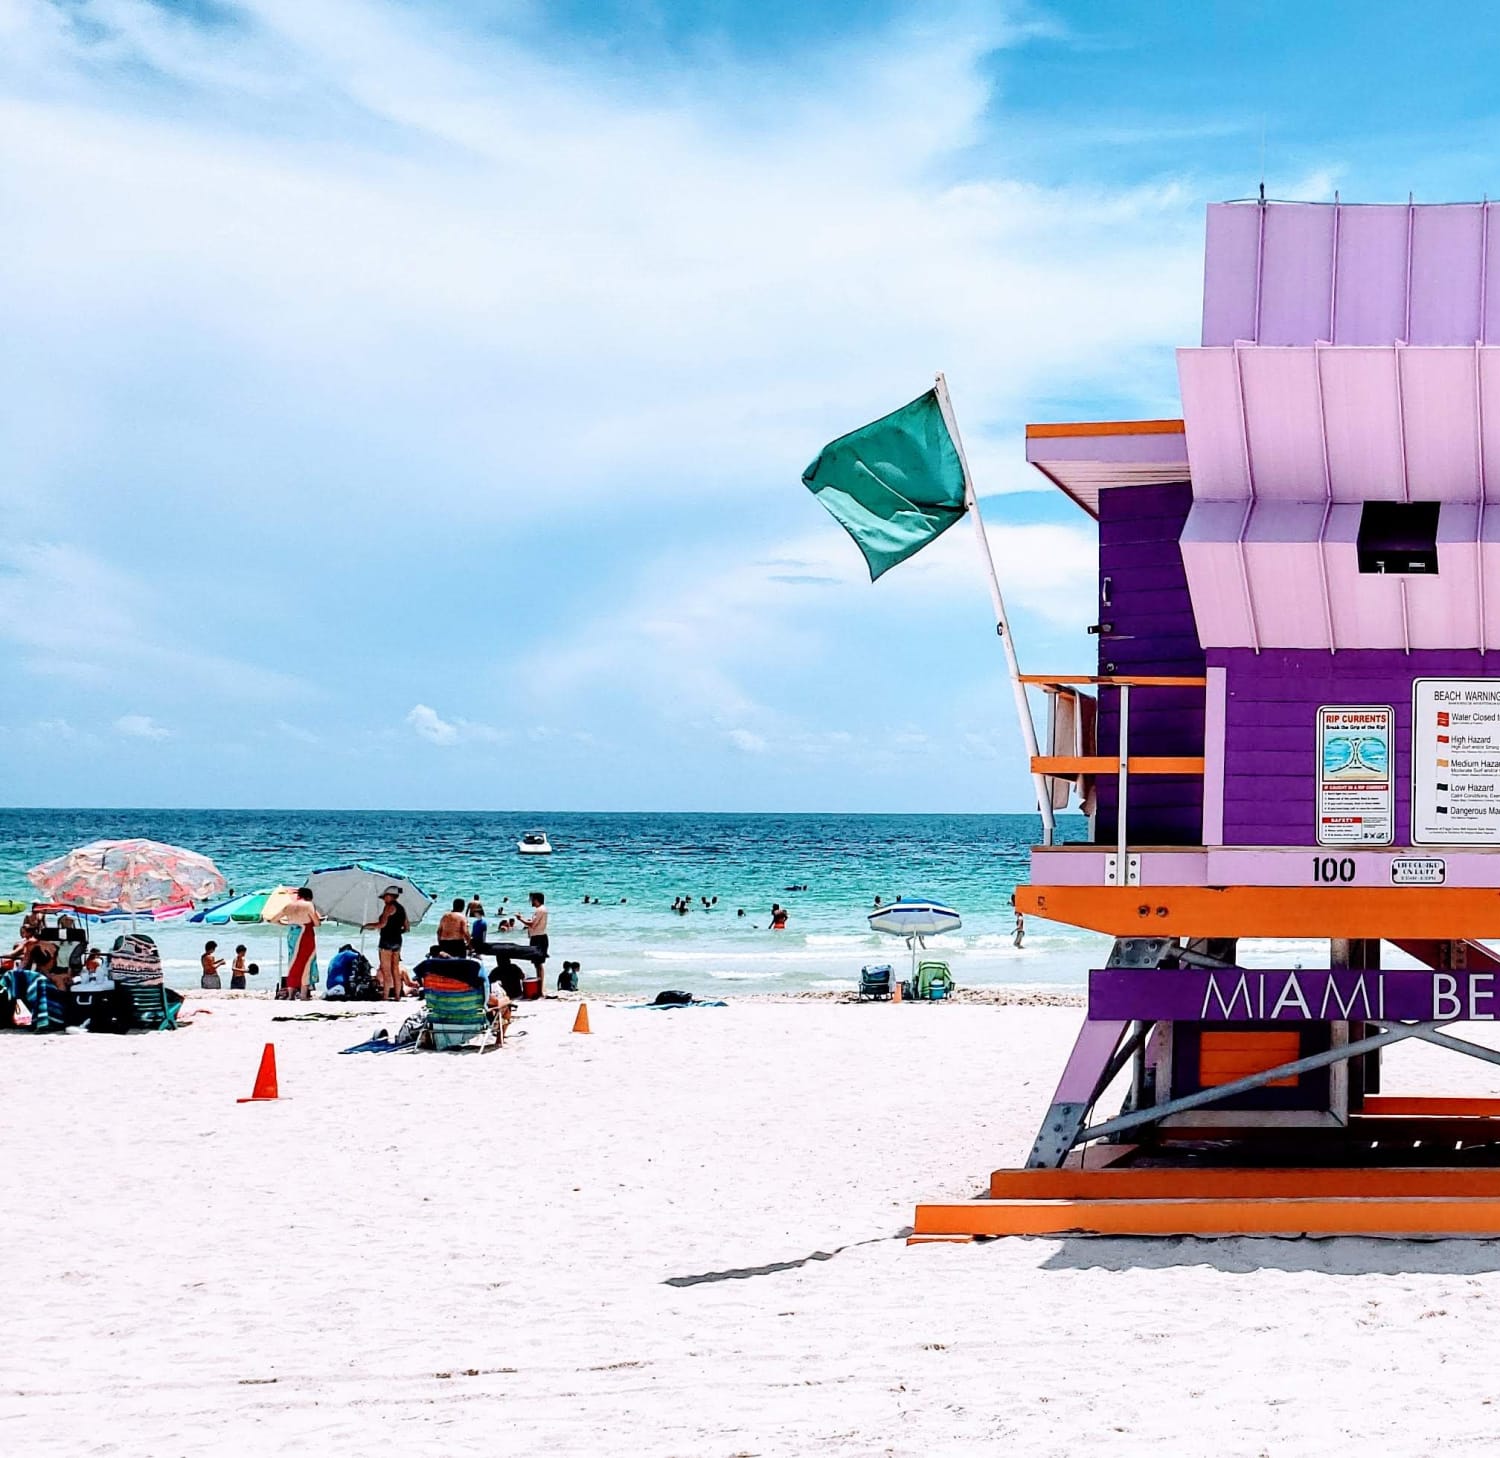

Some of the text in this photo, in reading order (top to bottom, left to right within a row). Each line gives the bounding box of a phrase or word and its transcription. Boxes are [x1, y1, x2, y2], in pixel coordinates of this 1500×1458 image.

[1434, 690, 1461, 701] BEACH
[1326, 714, 1387, 723] RIP CURRENTS
[1451, 713, 1471, 721] Water
[1472, 712, 1496, 721] Closed
[1451, 736, 1491, 745] High Hazard
[1450, 759, 1479, 768] Medium
[1450, 784, 1494, 792] Low Hazard
[1450, 807, 1487, 816] Dangerous
[1312, 856, 1356, 882] 100
[1201, 973, 1384, 1020] MIAMI
